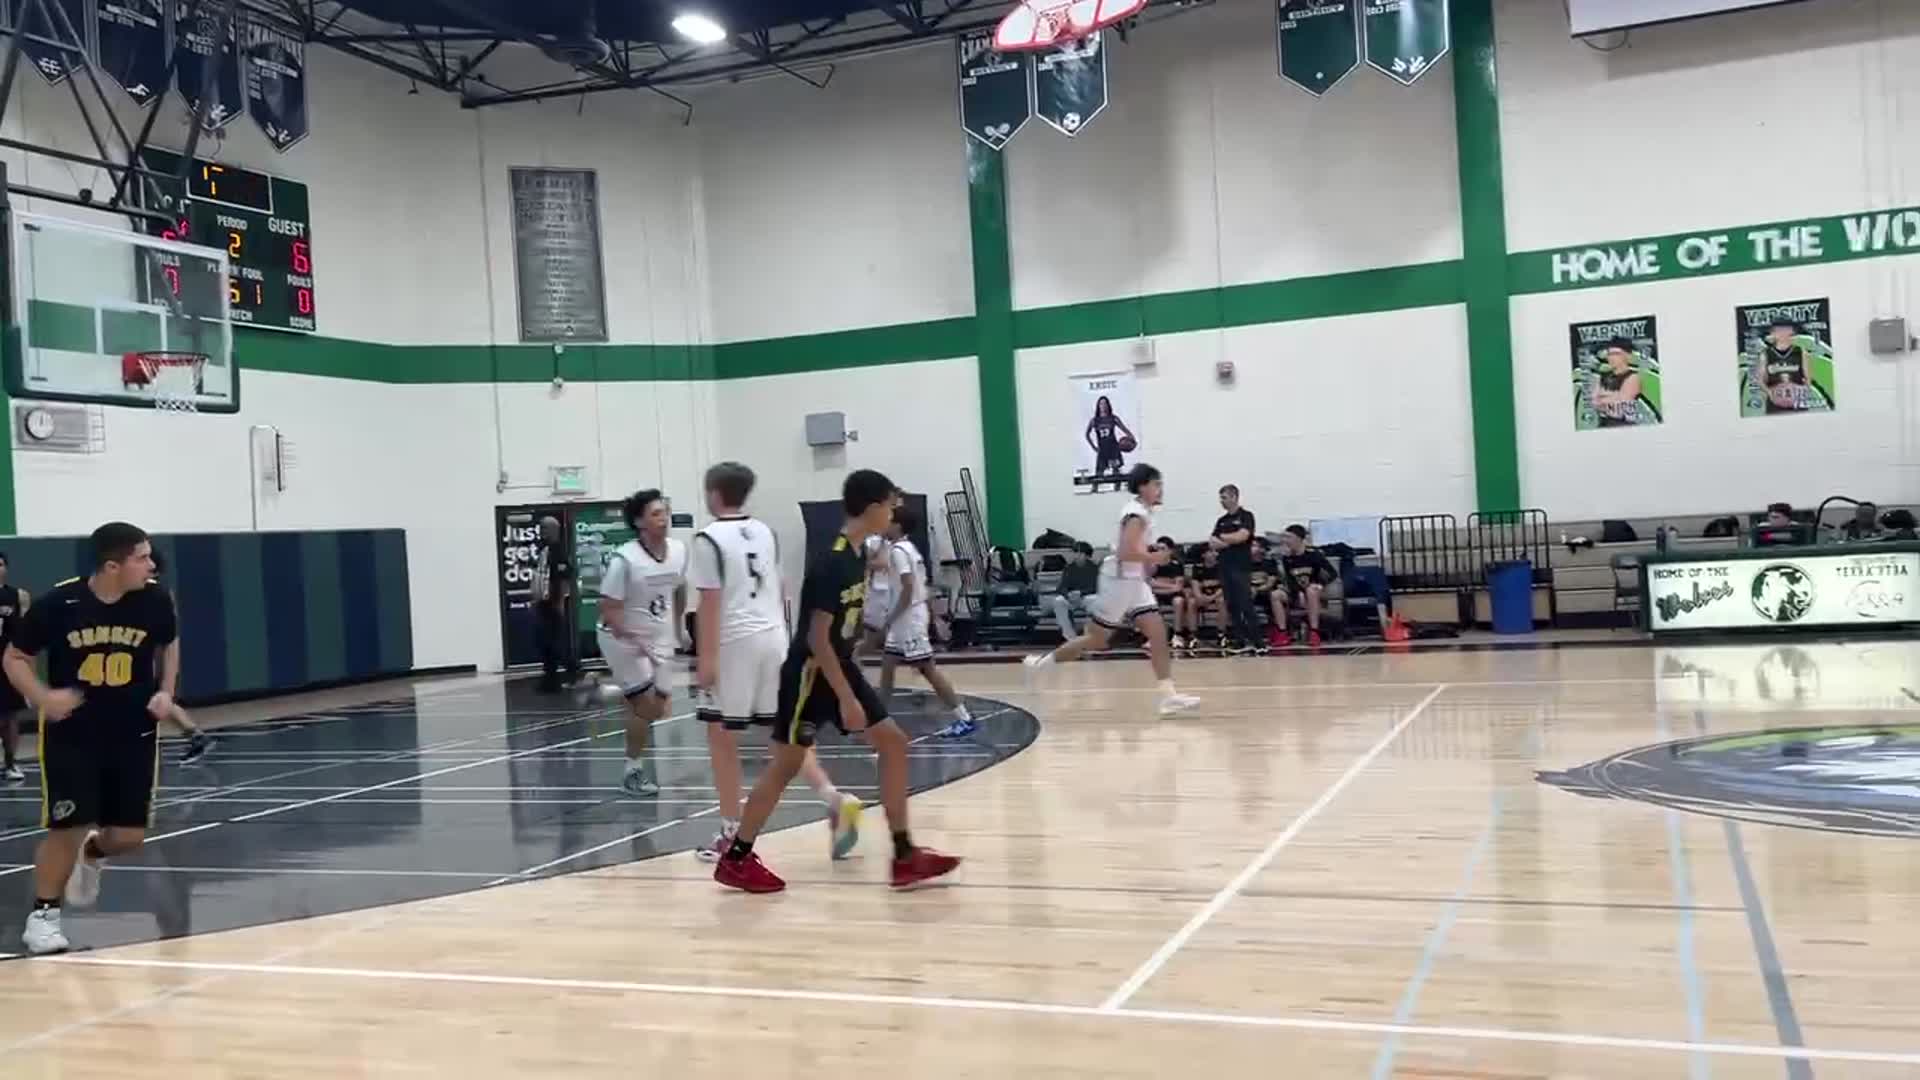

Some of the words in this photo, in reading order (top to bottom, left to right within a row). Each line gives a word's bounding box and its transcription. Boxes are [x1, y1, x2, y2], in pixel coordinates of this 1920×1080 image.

[268, 217, 305, 238] GUEST
[229, 232, 241, 258] 2
[292, 241, 309, 274] 6
[1552, 244, 1660, 284] HOME
[1675, 235, 1729, 270] OF
[1747, 225, 1824, 263] THE
[298, 289, 311, 314] 0
[1742, 302, 1821, 327] VARSITY
[1577, 320, 1648, 343] VARSITY
[503, 543, 539, 565] get
[77, 652, 133, 687] 40
